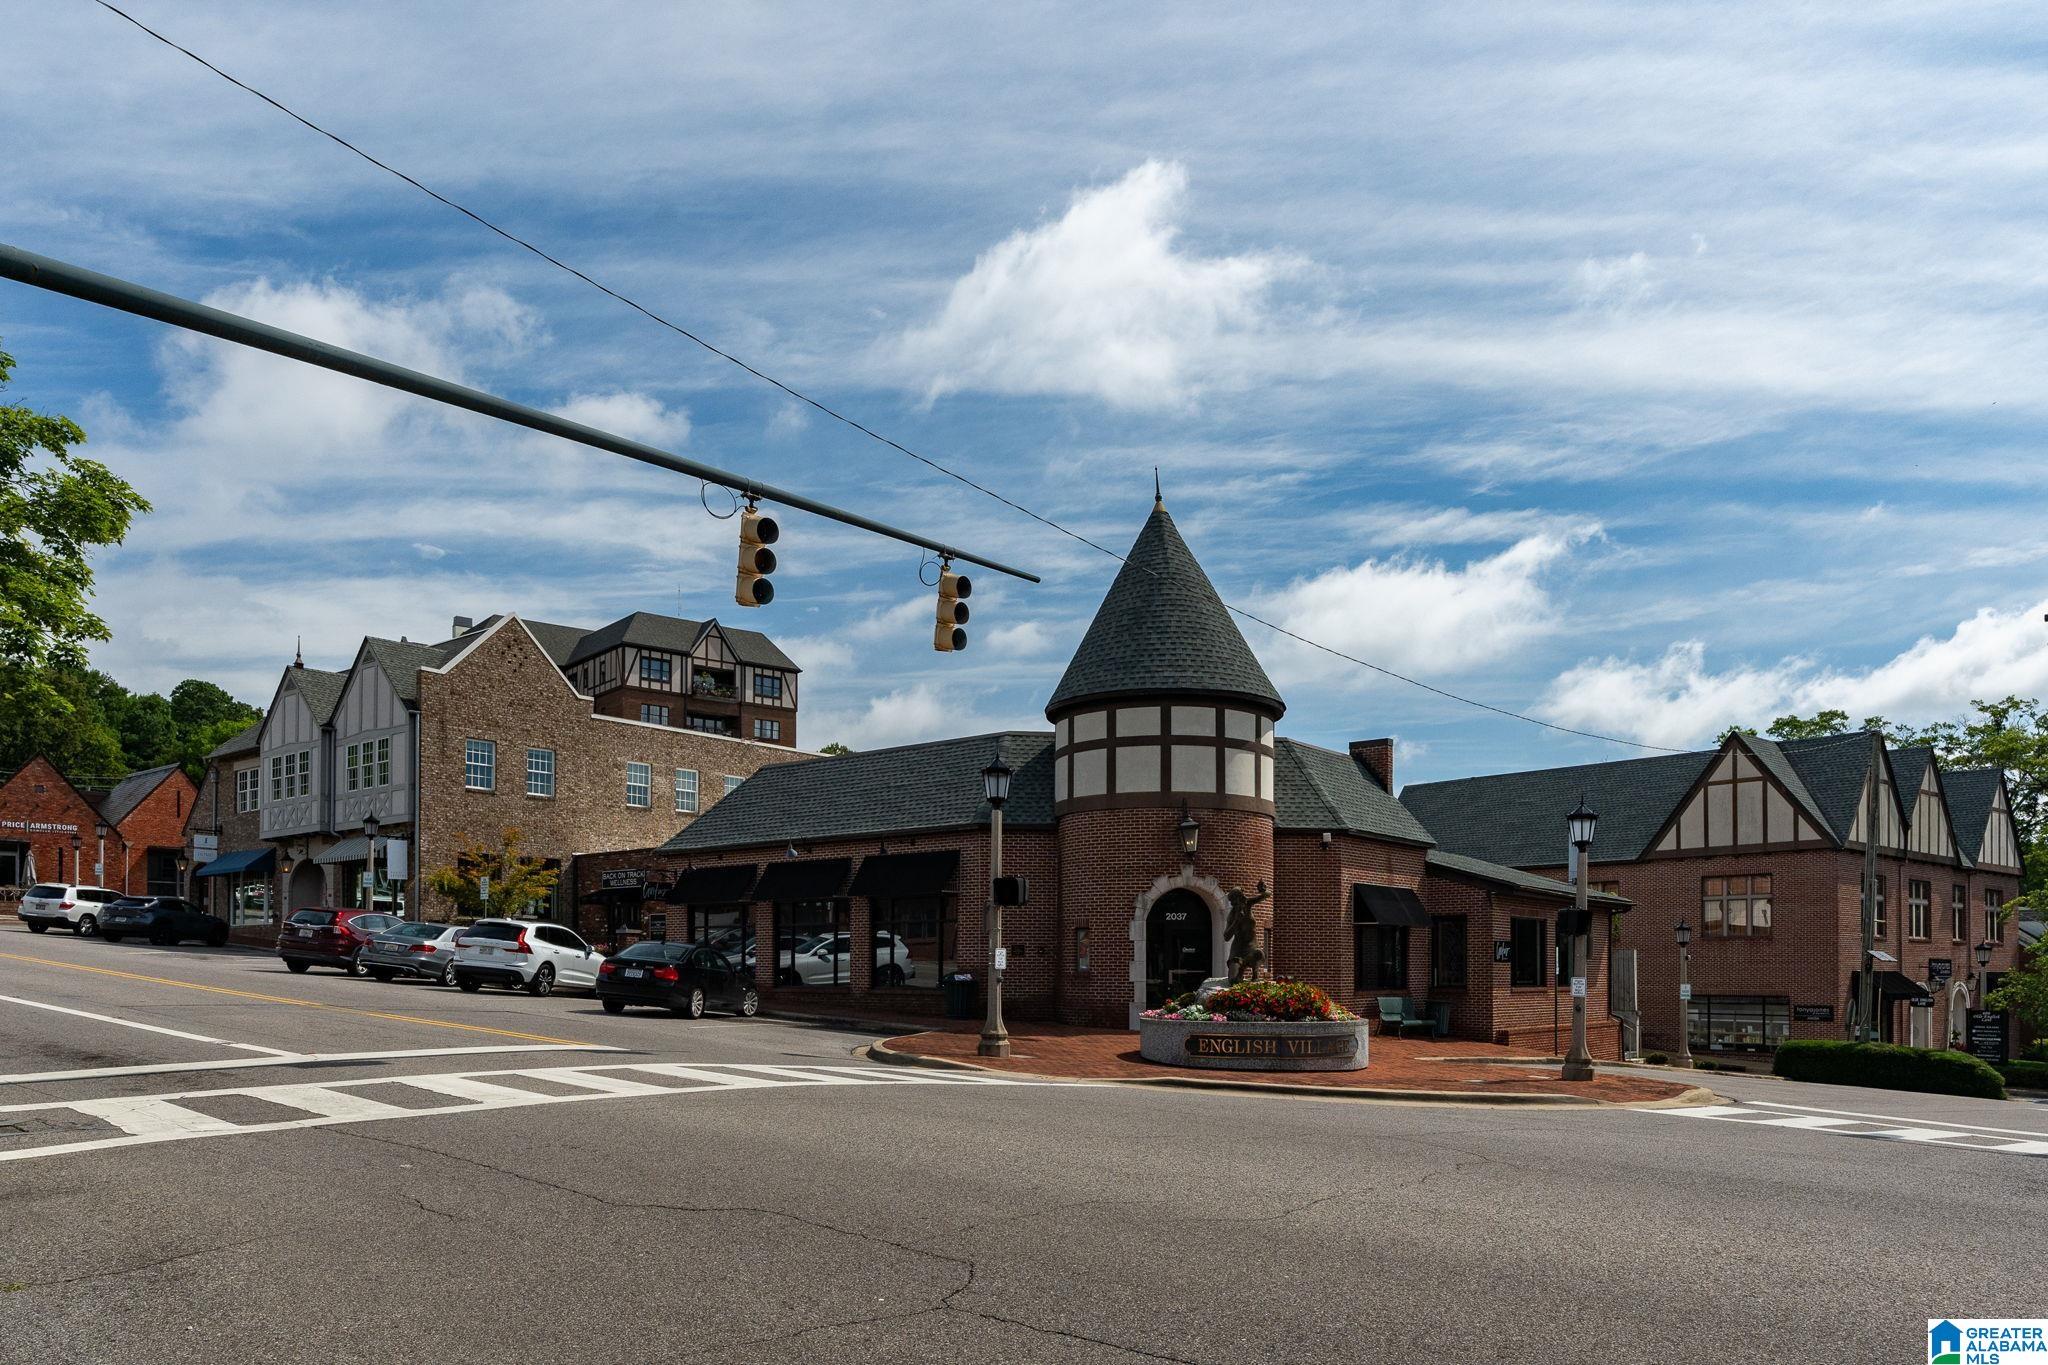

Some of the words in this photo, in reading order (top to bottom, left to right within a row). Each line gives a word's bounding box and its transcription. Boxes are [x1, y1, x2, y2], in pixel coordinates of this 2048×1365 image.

[30, 822, 78, 831] ARMSTRONG
[602, 872, 617, 880] BACK
[627, 870, 644, 878] TRACK
[610, 878, 637, 886] WELLNESS
[1166, 912, 1187, 921] 2037
[1198, 1039, 1277, 1054] ENGLISH
